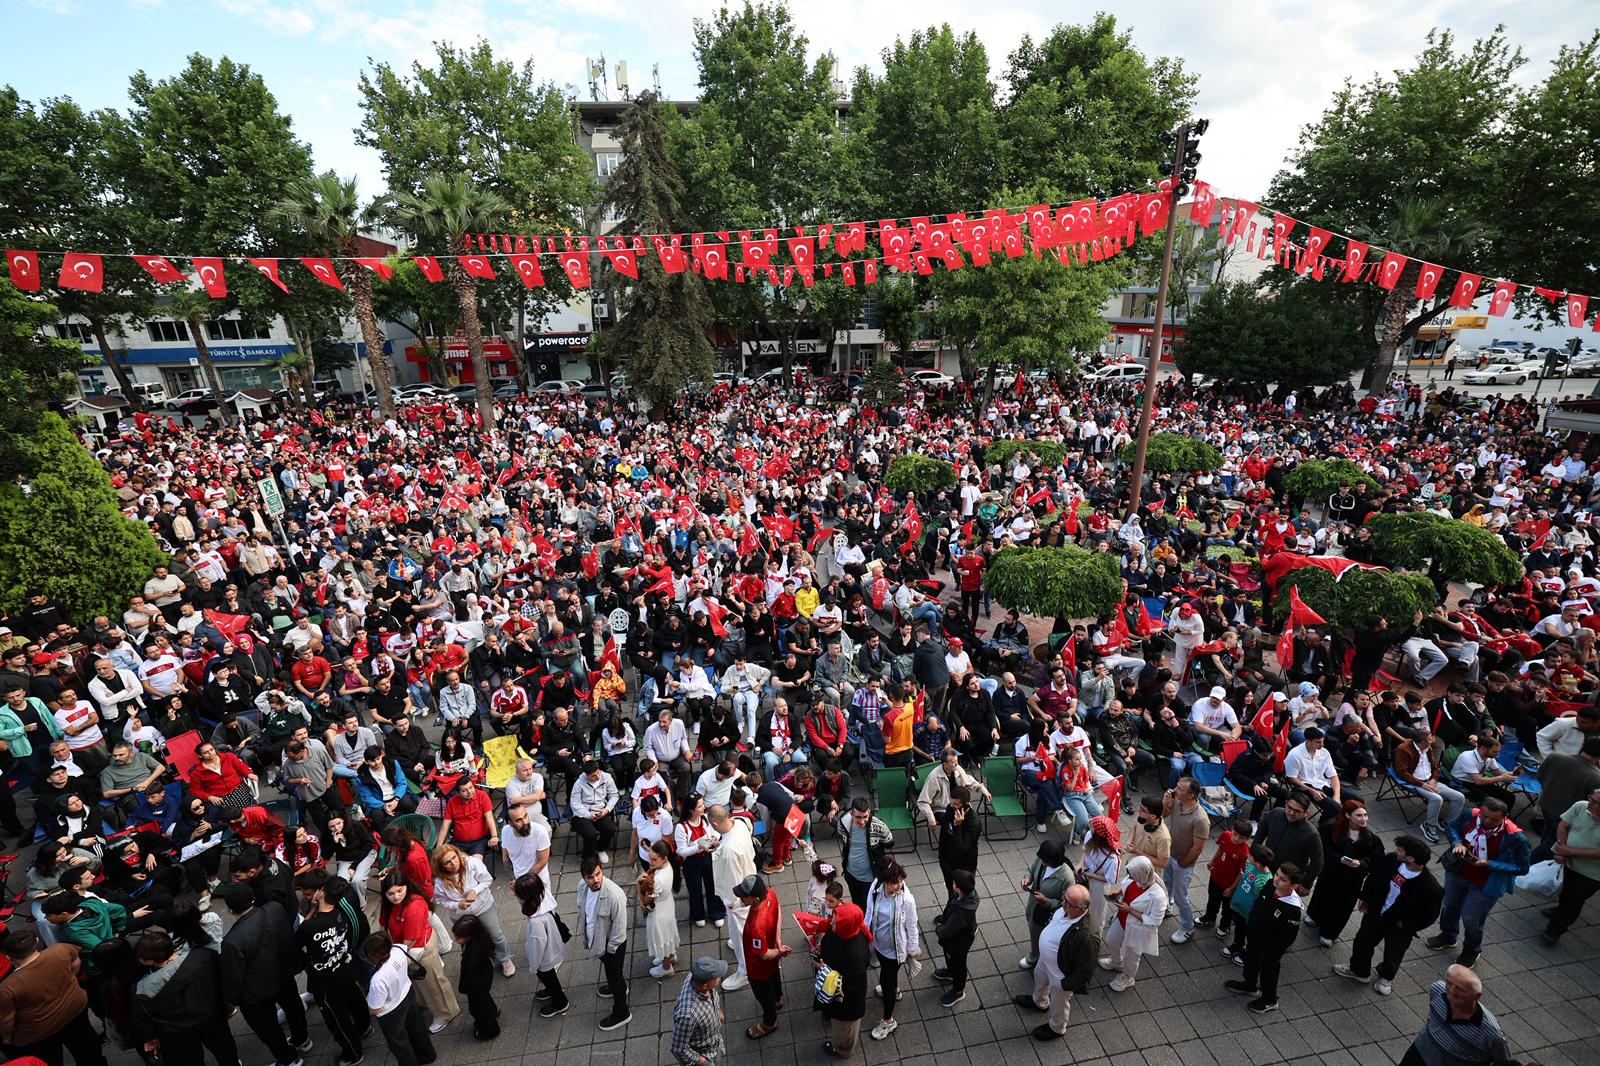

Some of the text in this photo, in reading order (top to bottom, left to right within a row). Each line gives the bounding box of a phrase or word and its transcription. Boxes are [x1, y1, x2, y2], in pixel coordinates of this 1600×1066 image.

[538, 336, 588, 348] powerace
[1242, 880, 1251, 893] 23
[313, 927, 336, 941] Only
